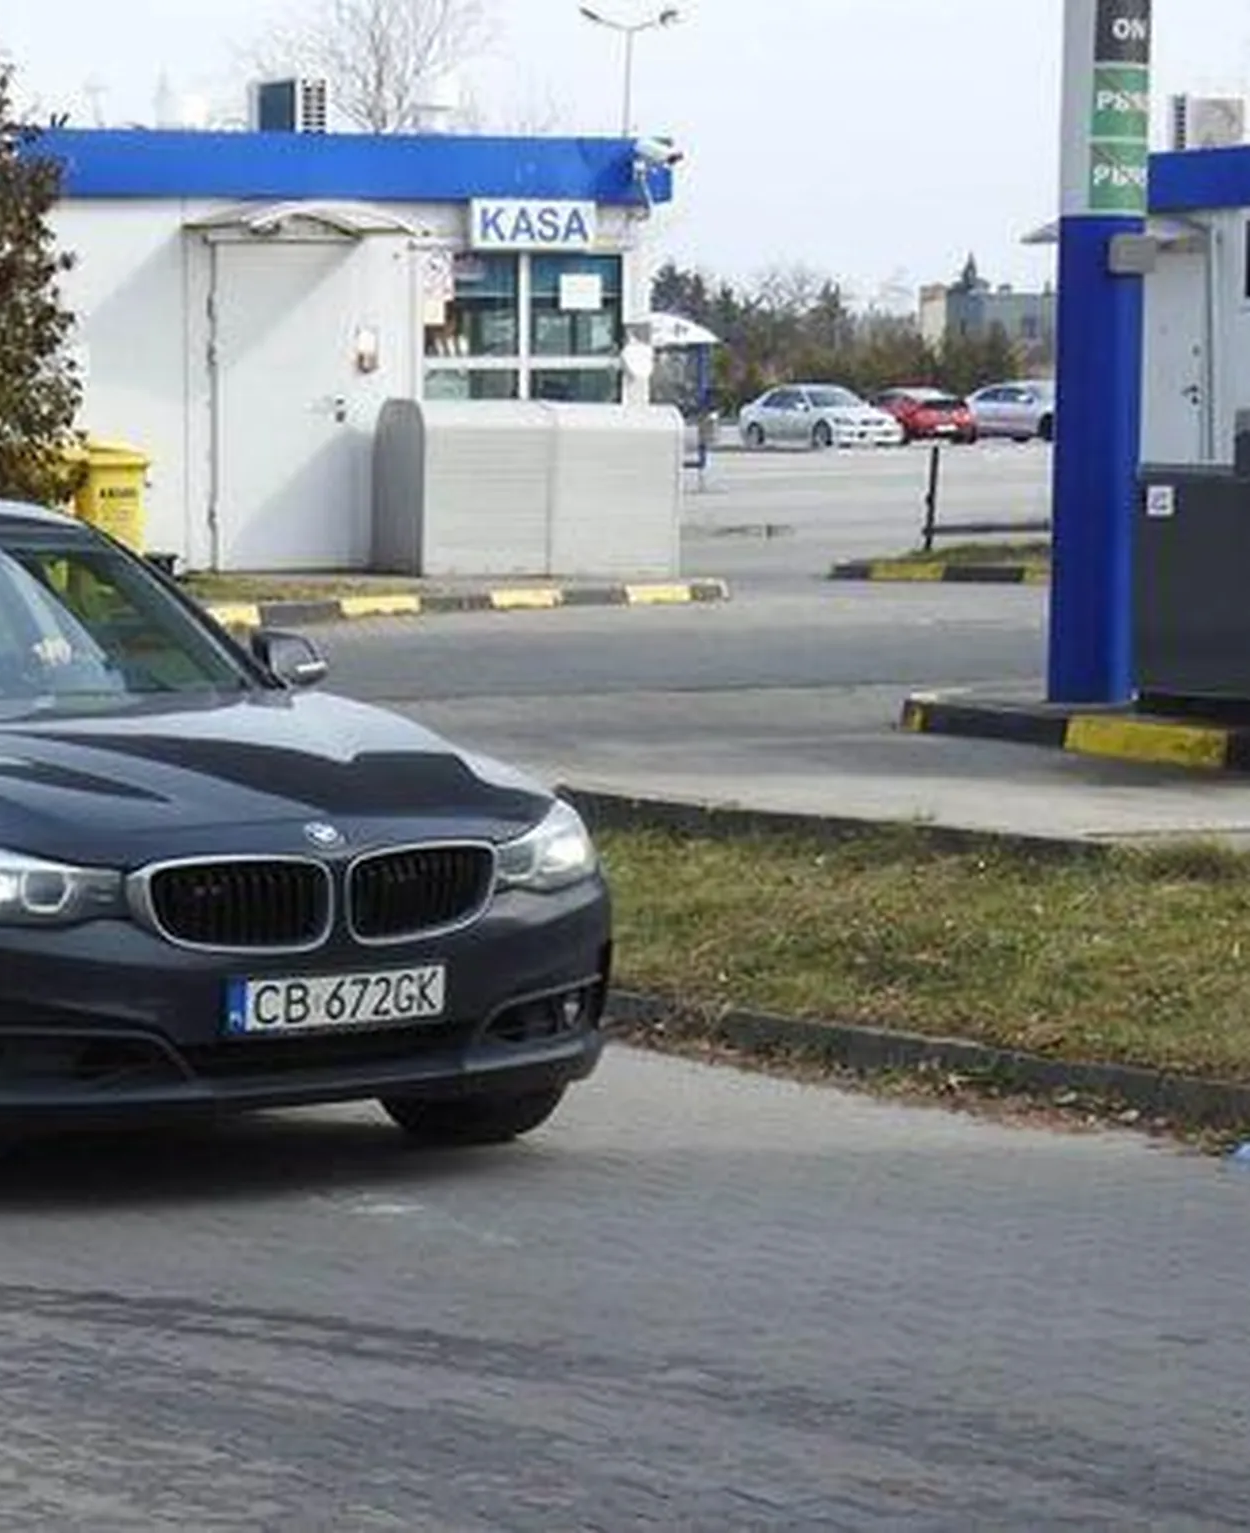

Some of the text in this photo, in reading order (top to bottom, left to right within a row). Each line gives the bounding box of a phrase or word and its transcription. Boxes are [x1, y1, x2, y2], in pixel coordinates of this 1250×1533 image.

[479, 206, 590, 243] KASA
[254, 983, 311, 1025] CB
[325, 970, 439, 1021] 672GK
